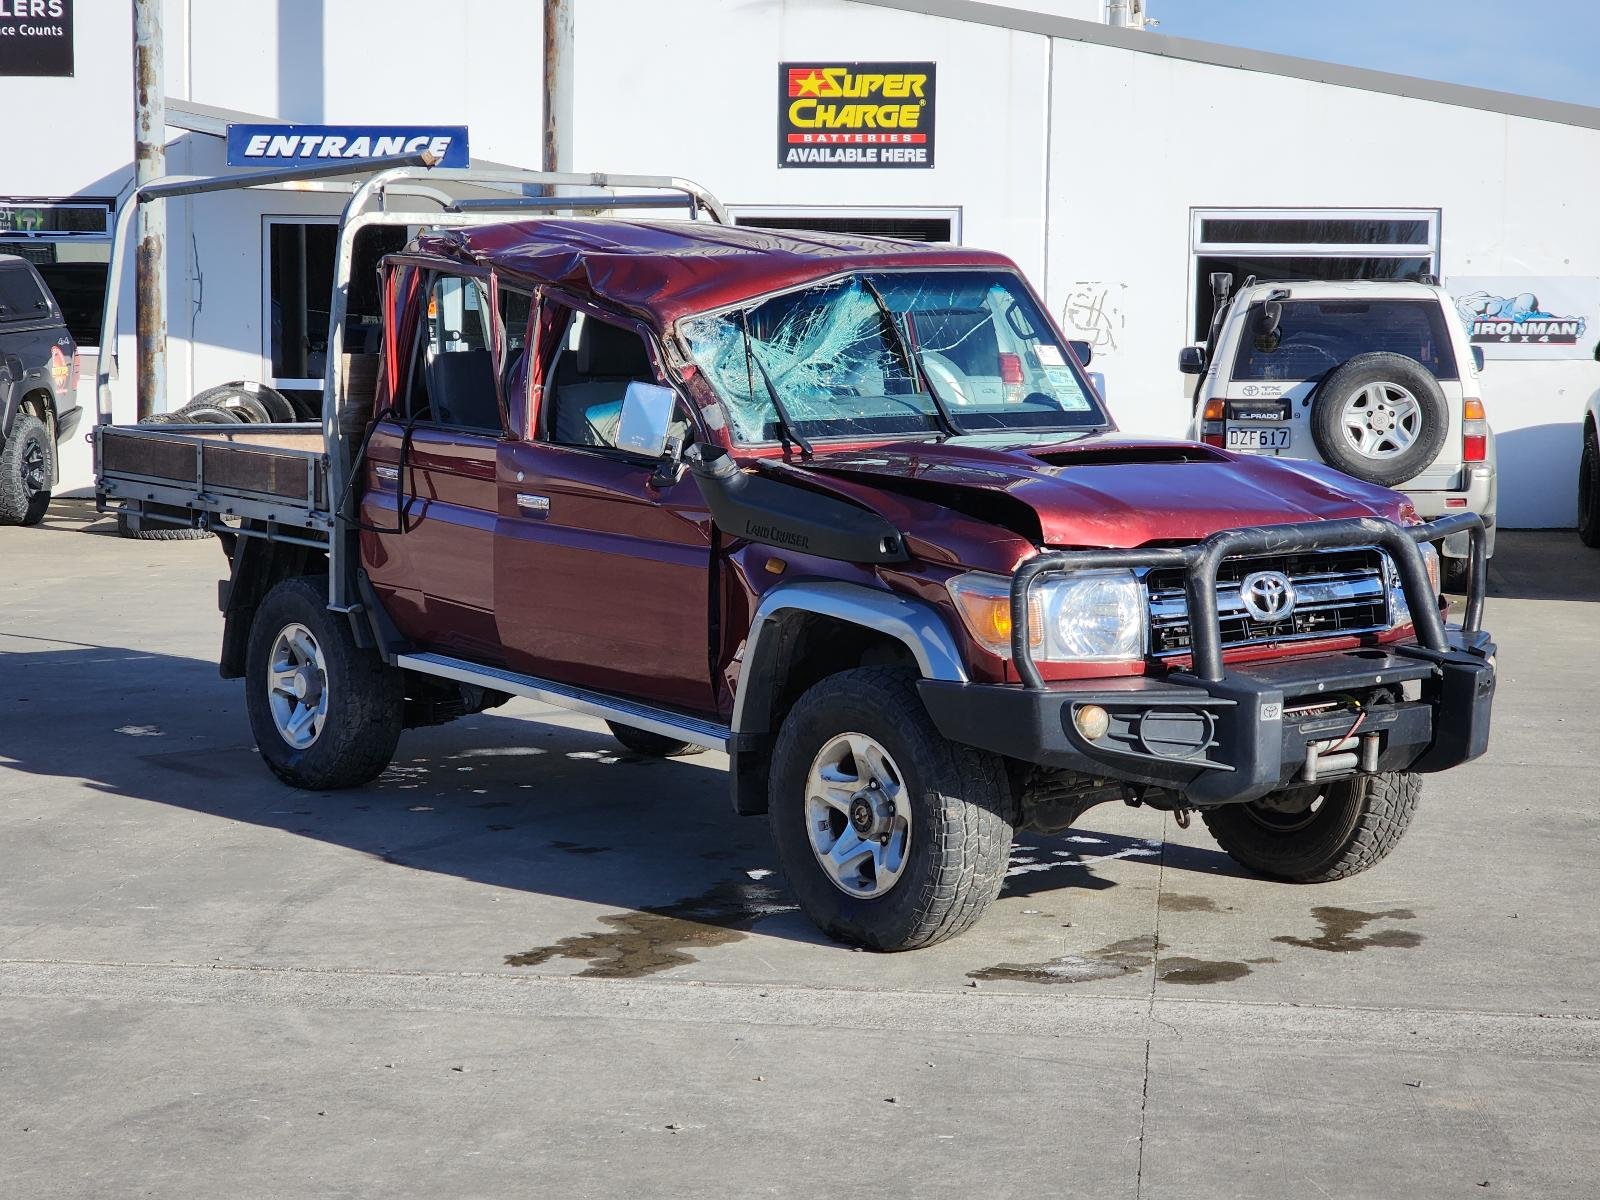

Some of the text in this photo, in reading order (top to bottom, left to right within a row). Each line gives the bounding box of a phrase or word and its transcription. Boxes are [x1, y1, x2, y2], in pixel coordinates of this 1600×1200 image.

[19, 24, 64, 36] Counts
[803, 133, 912, 143] BATTERIES
[244, 135, 452, 159] ENTRANCE
[786, 148, 927, 163] AVAILABLE HERE
[1473, 322, 1578, 335] IRONMAN
